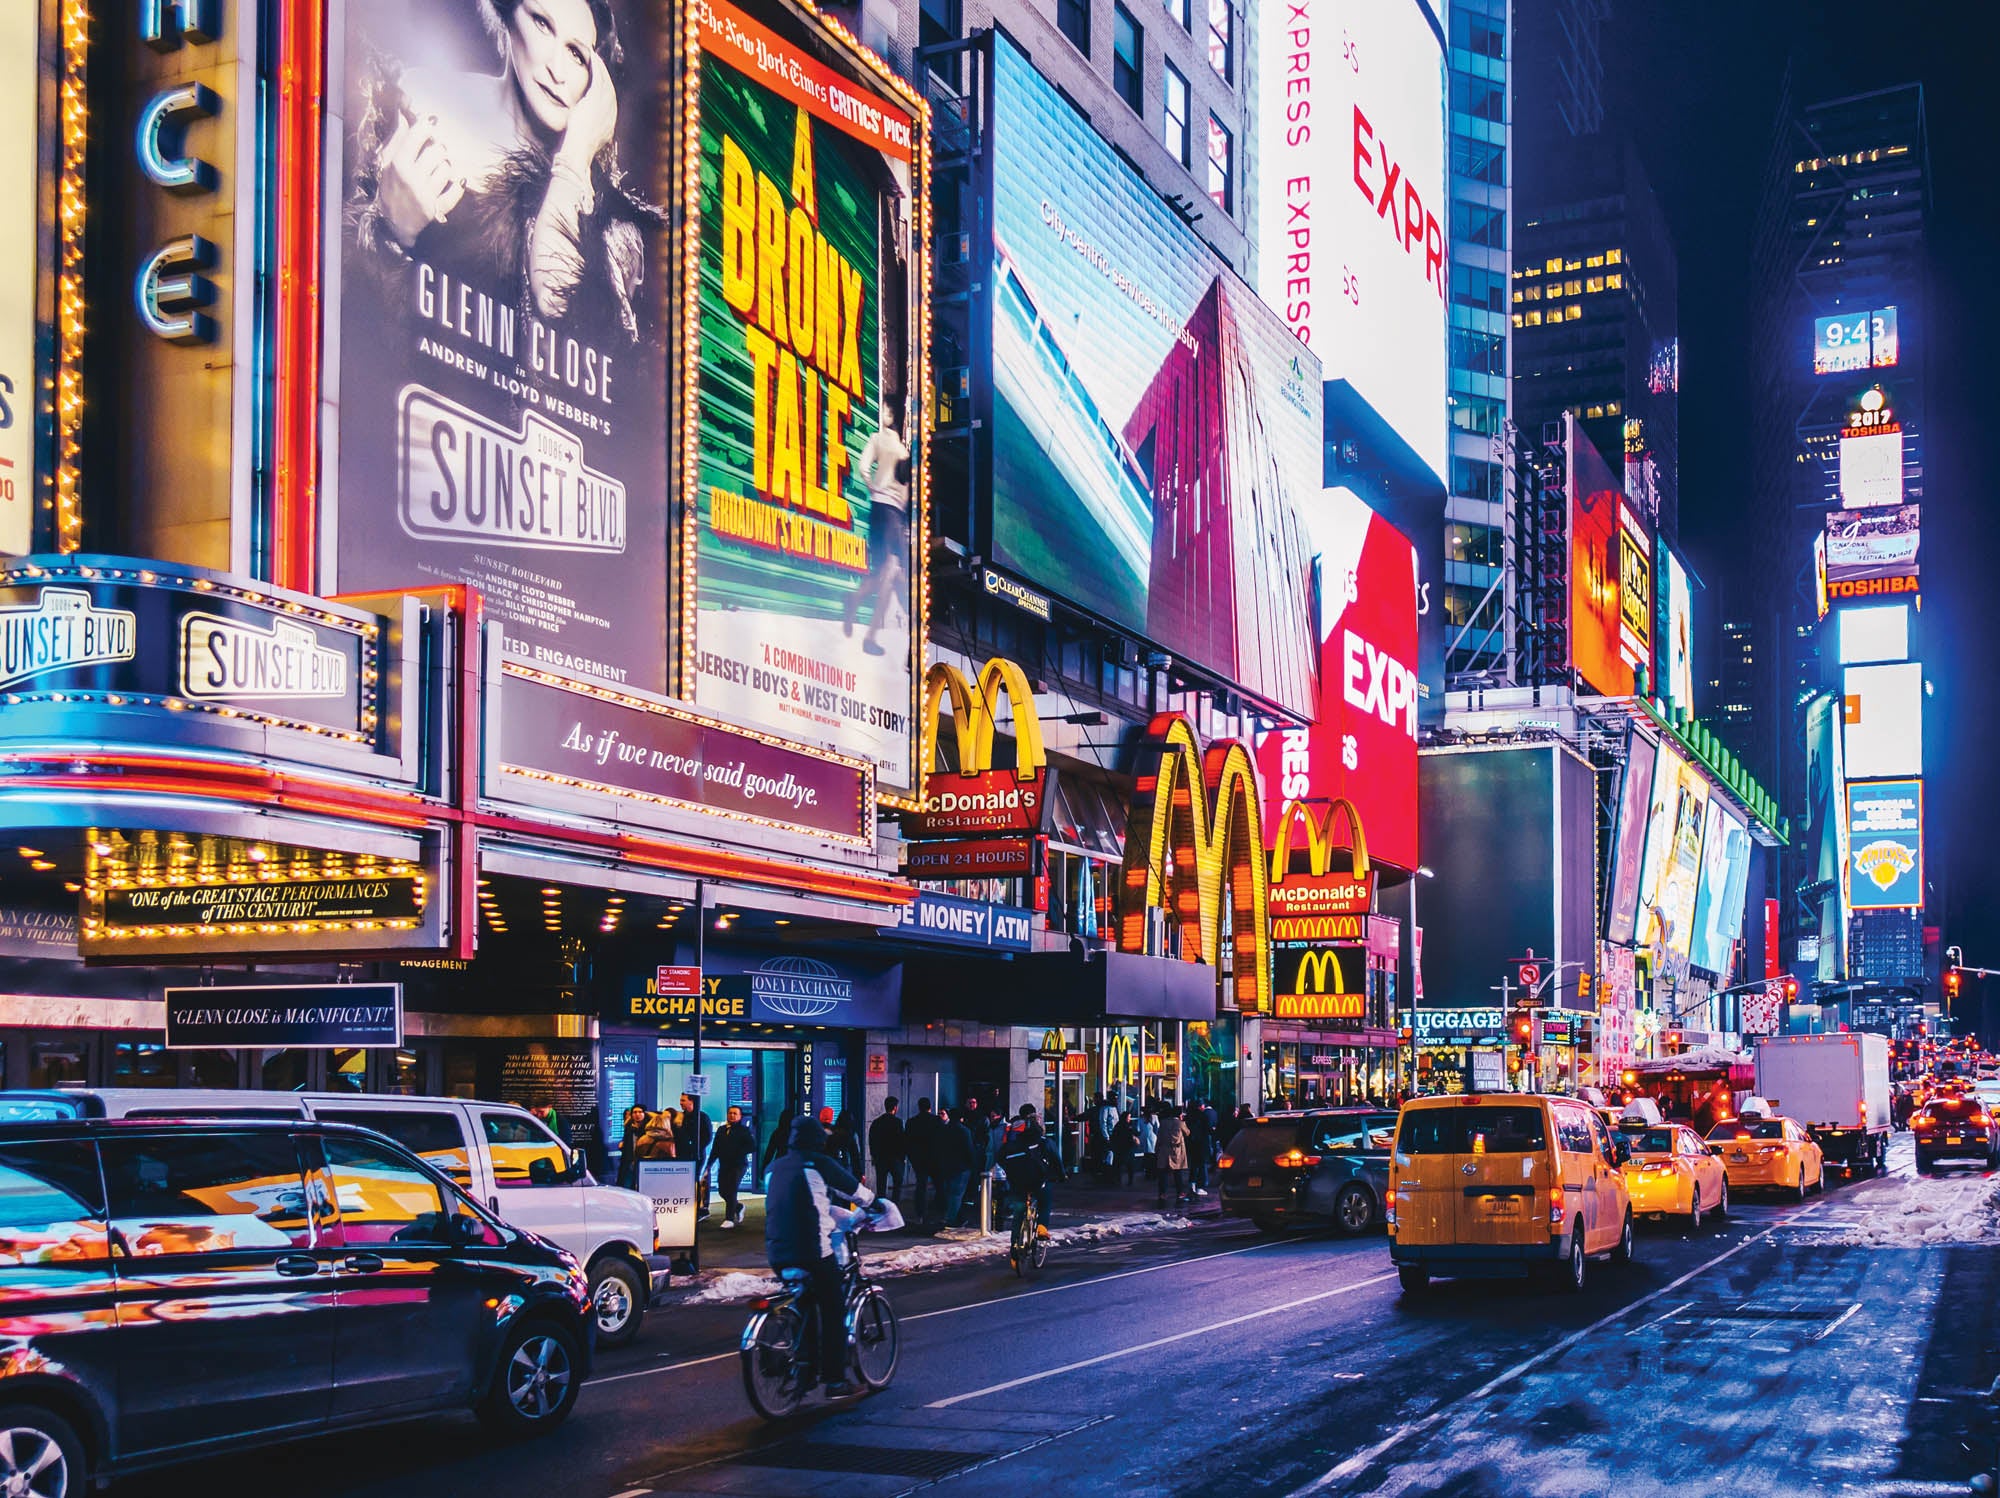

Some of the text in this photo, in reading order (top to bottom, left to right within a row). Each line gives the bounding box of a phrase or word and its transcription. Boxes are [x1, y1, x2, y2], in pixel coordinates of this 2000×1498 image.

[700, 3, 912, 149] The New York Times CRITICS' PICK
[791, 105, 818, 225] A
[722, 134, 864, 400] BRONX
[1286, 176, 1311, 346] EXPRESS
[1041, 200, 1200, 359] City-centric services industry
[418, 263, 614, 404] GLENN CLOSE
[1826, 318, 1885, 347] 9:43
[419, 337, 611, 436] ANDREW LLOYD WEBBER'S
[515, 363, 527, 378] in
[746, 322, 850, 524] TALE
[1841, 422, 1900, 438] TOSHIBA
[430, 420, 622, 544] SUNSET BLVD.
[710, 486, 868, 570] BROADWAY'S NEW HIT MUSICAL
[473, 554, 563, 590] SUNSET BOULEVARD
[1827, 576, 1919, 598] TOSHIBA
[466, 577, 485, 590] DON
[487, 582, 512, 599] BLACK
[521, 596, 572, 618] CHRISTOPHER
[574, 611, 611, 629] HAMPTON
[485, 573, 519, 590] ANDREW
[521, 582, 545, 599] LLOYD
[547, 590, 576, 608] WEBBER
[505, 601, 524, 615] BILLY
[528, 606, 556, 622] WILDER
[509, 611, 535, 627] LONNY
[538, 620, 560, 633] PRICE
[0, 616, 131, 675] UNSET BLVD.
[206, 630, 343, 690] SUNSET BLVD.
[535, 647, 627, 683] ENGAGEMENT
[773, 648, 843, 692] COMBINATION
[845, 672, 857, 693] OF
[697, 651, 750, 686] JERSEY
[752, 667, 788, 699] BOYS
[791, 680, 800, 702] &
[803, 686, 838, 714] WEST
[841, 696, 867, 722] SIDE
[561, 721, 818, 809] As if we never said goodbye.
[928, 789, 1035, 813] cDonald's
[926, 812, 1013, 828] Restaurant
[911, 850, 1026, 866] OPEN 24 HOURS
[160, 893, 173, 909] of
[173, 892, 191, 906] the
[192, 888, 238, 905] GREAT
[237, 886, 279, 904] STAGE
[281, 882, 390, 902] PERFORMANCES
[1270, 885, 1366, 902] McDonald's
[1286, 901, 1350, 912] Restaurant
[23, 912, 75, 929] CLOSE
[202, 906, 216, 924] of
[214, 904, 246, 919] THIS
[920, 904, 1030, 941] MONEY ATM
[752, 975, 852, 998] ONEY EXCHANGE
[225, 1008, 270, 1024] CLOSE
[271, 1009, 282, 1024] is
[569, 1061, 591, 1069] COME
[803, 1044, 812, 1095] MONEY
[654, 1206, 678, 1214] ZONE
[672, 1197, 689, 1206] OFF
